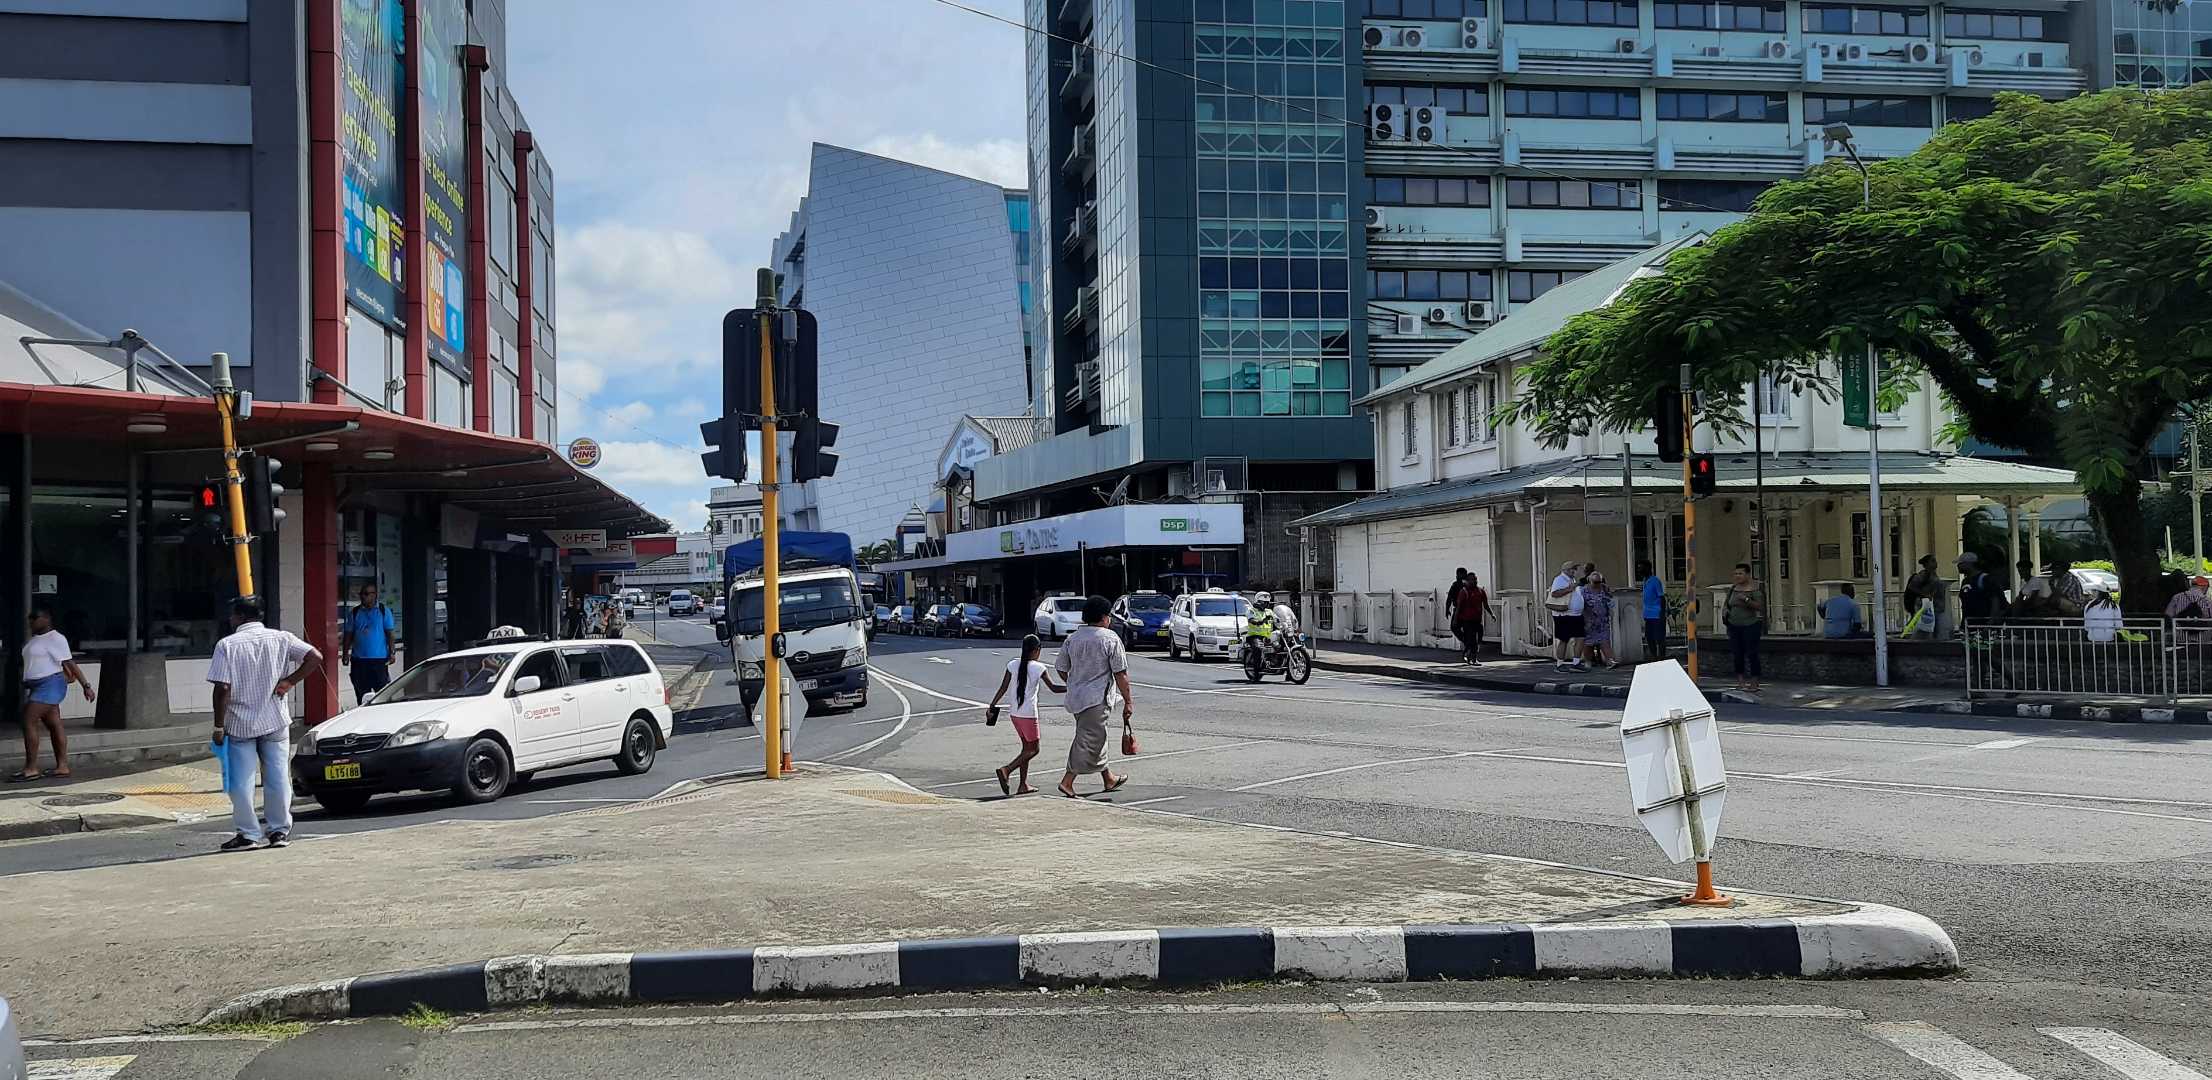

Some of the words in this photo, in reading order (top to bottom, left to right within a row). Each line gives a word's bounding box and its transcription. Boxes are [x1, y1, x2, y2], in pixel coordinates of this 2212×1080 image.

[432, 154, 446, 193] best
[447, 178, 464, 213] online
[571, 451, 597, 459] KING
[1162, 520, 1185, 530] bsp
[574, 533, 601, 543] HFC
[491, 628, 514, 638] TAXI
